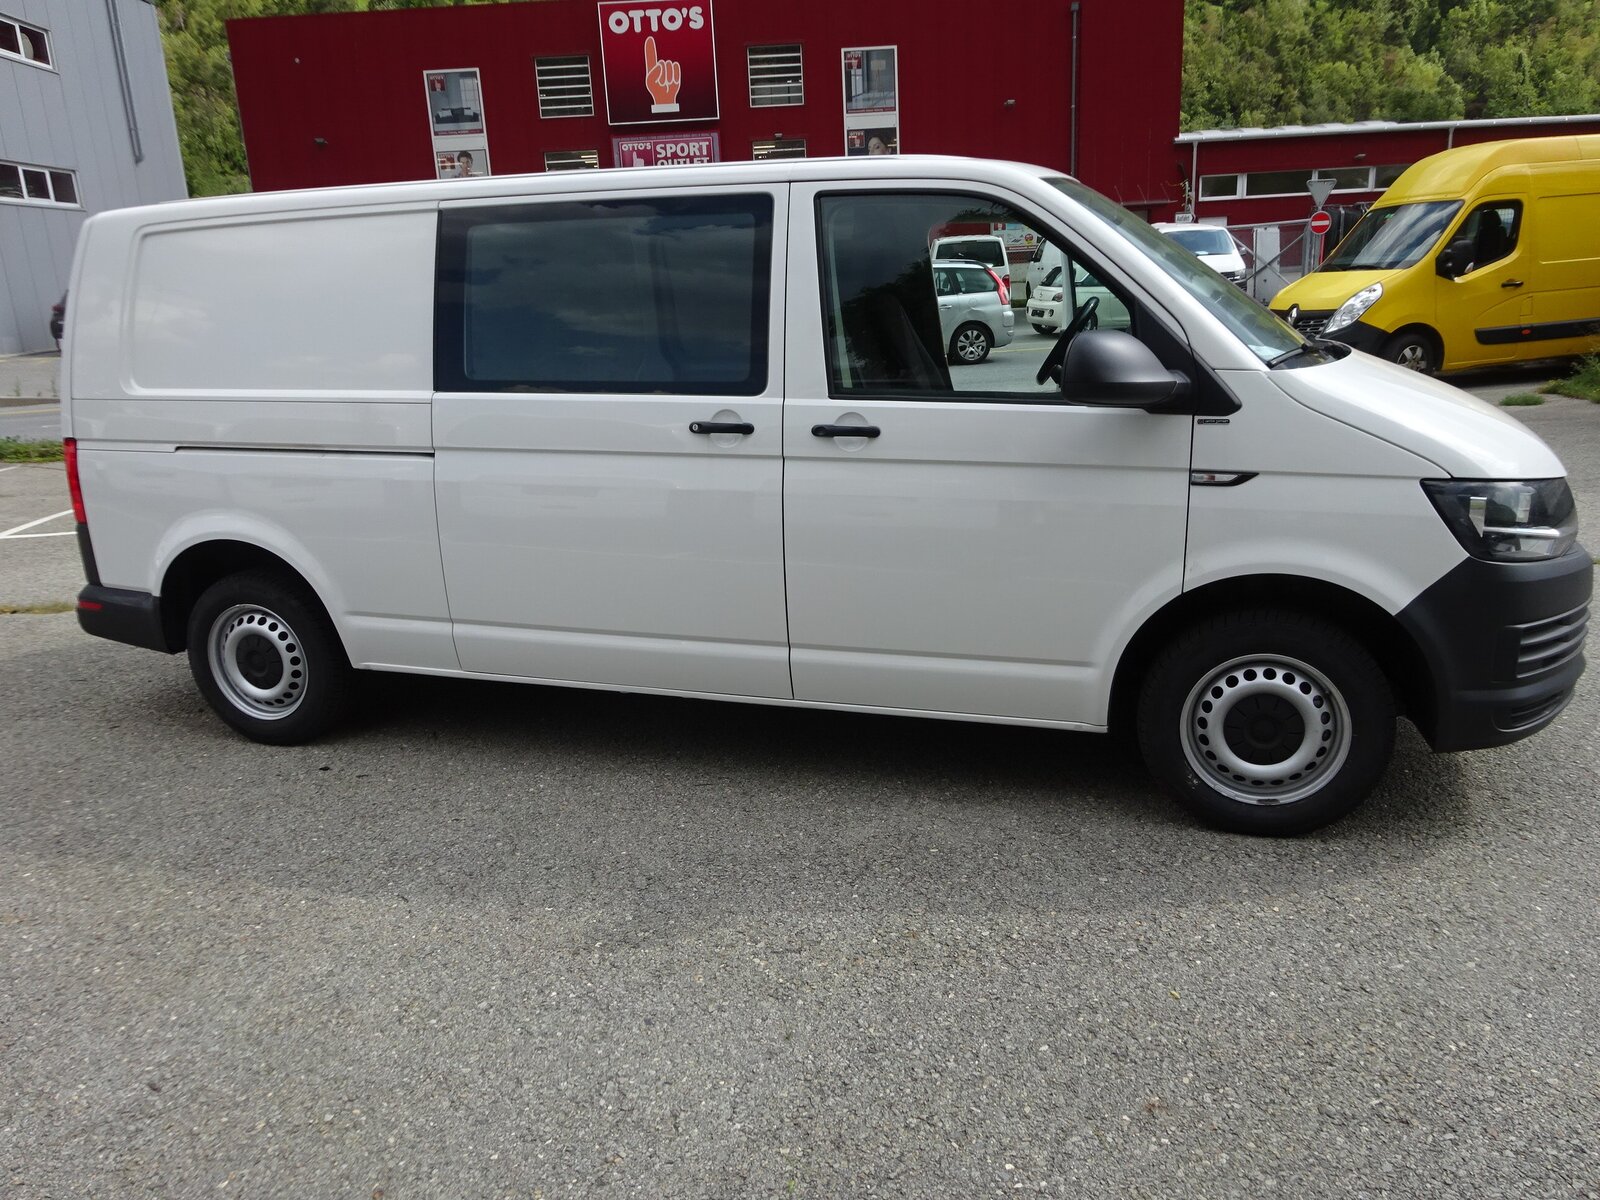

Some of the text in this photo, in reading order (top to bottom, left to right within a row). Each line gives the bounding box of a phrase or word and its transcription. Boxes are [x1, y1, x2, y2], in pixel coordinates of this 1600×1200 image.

[608, 5, 704, 34] OTTO'S
[621, 142, 652, 151] OTTO'S
[655, 141, 709, 158] SPORT
